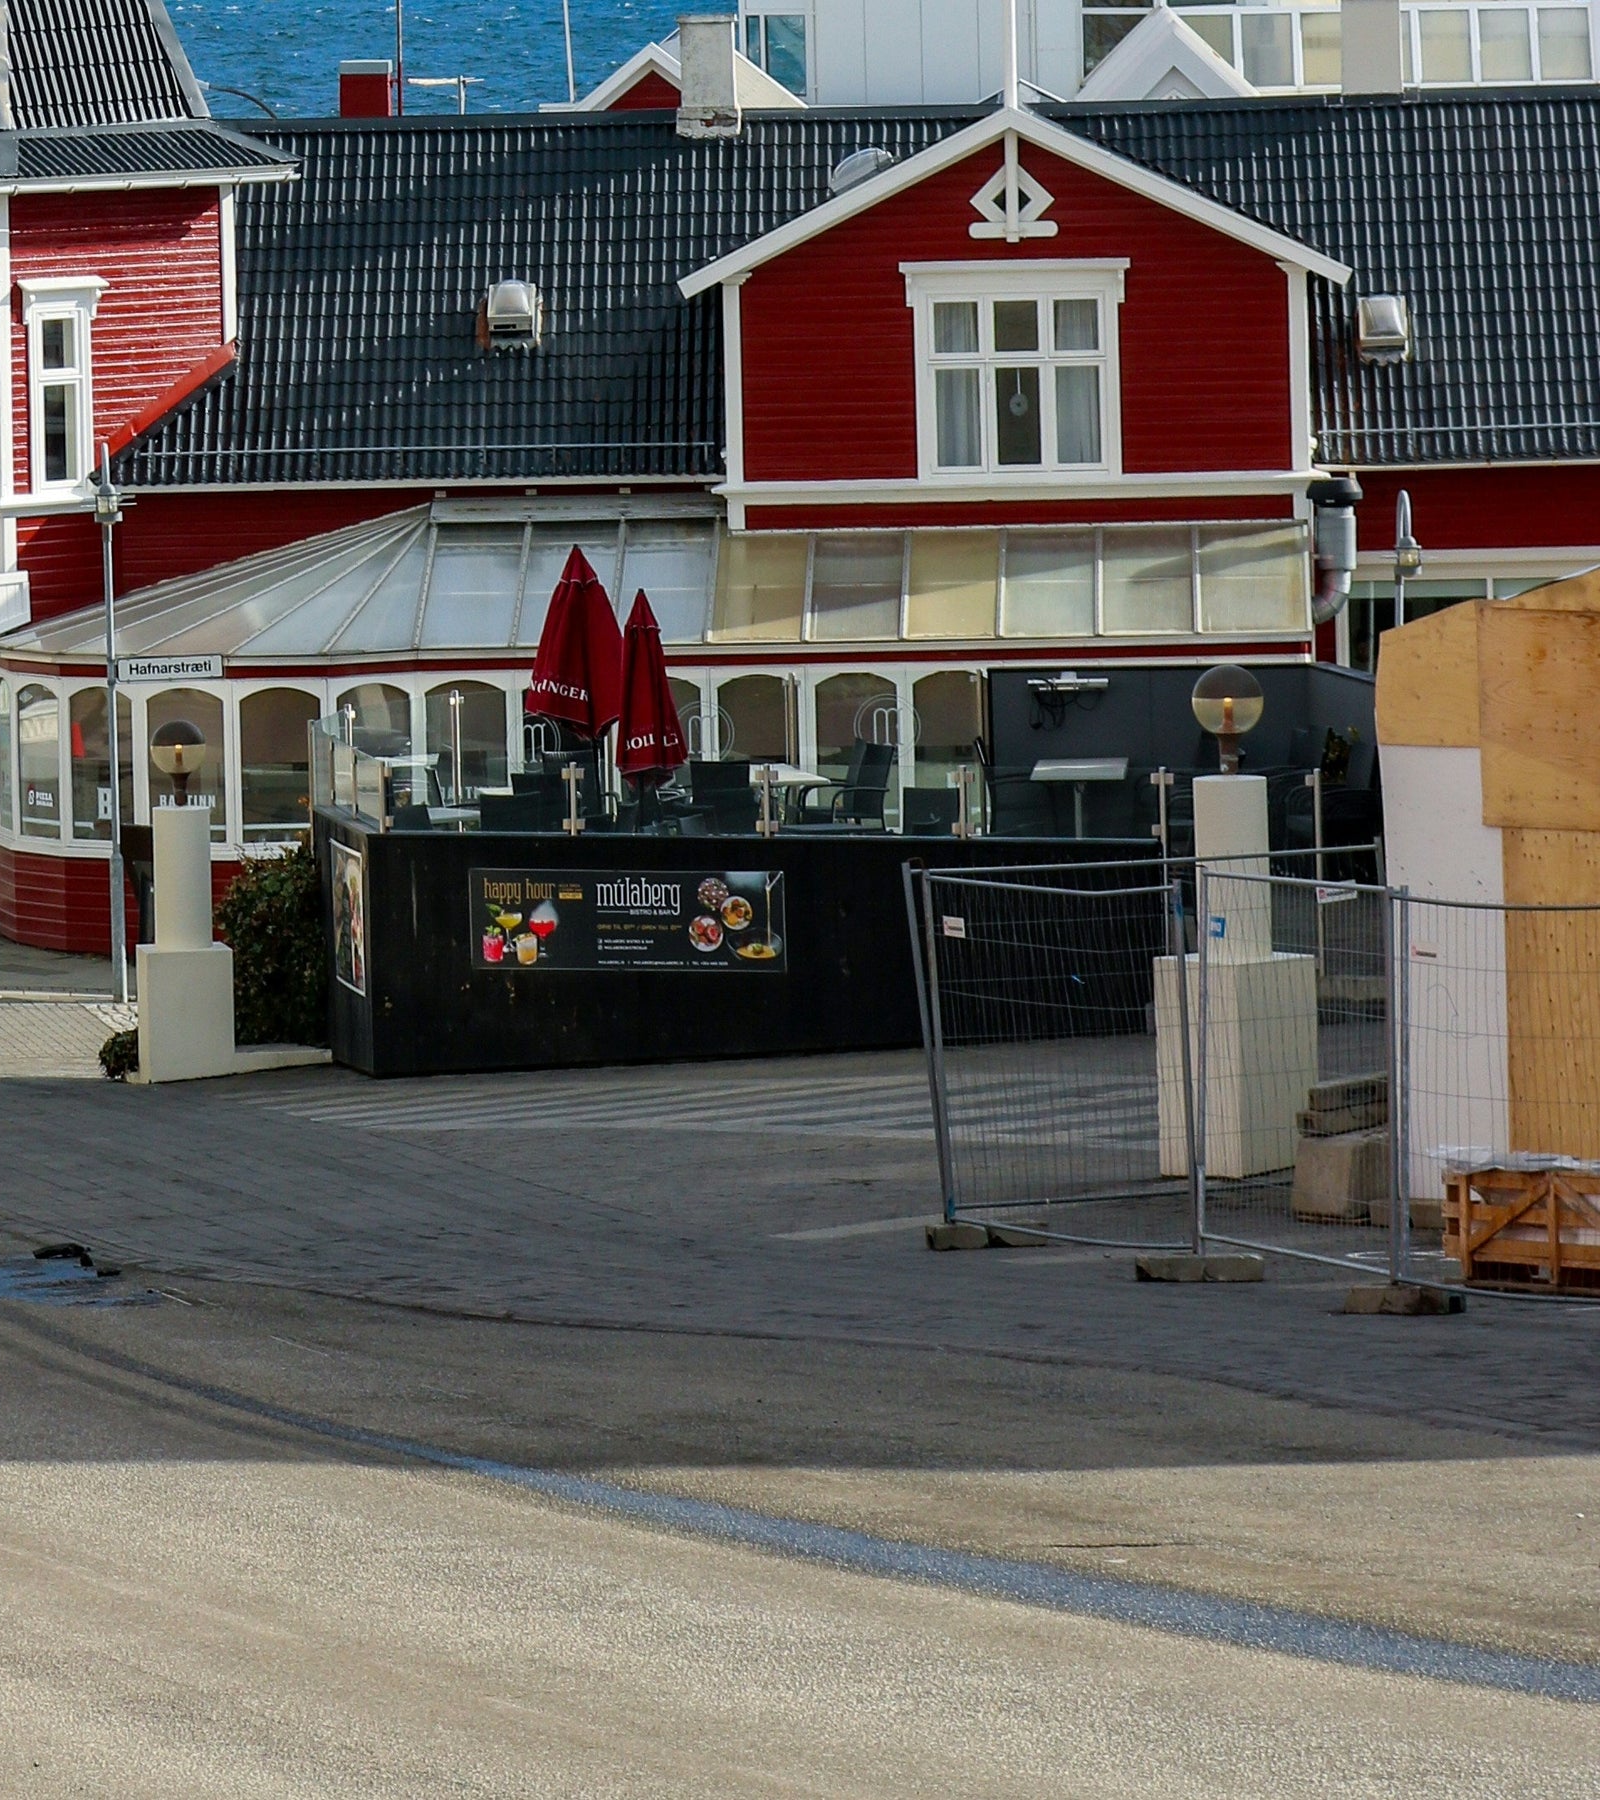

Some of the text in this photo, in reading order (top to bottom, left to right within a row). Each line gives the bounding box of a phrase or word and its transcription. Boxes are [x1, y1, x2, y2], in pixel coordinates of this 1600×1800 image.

[129, 660, 212, 675] Hafnarstræti
[483, 877, 556, 905] happy hour
[596, 877, 681, 916] múlaberg
[629, 908, 653, 916] BISTRO
[658, 908, 672, 916] BAR
